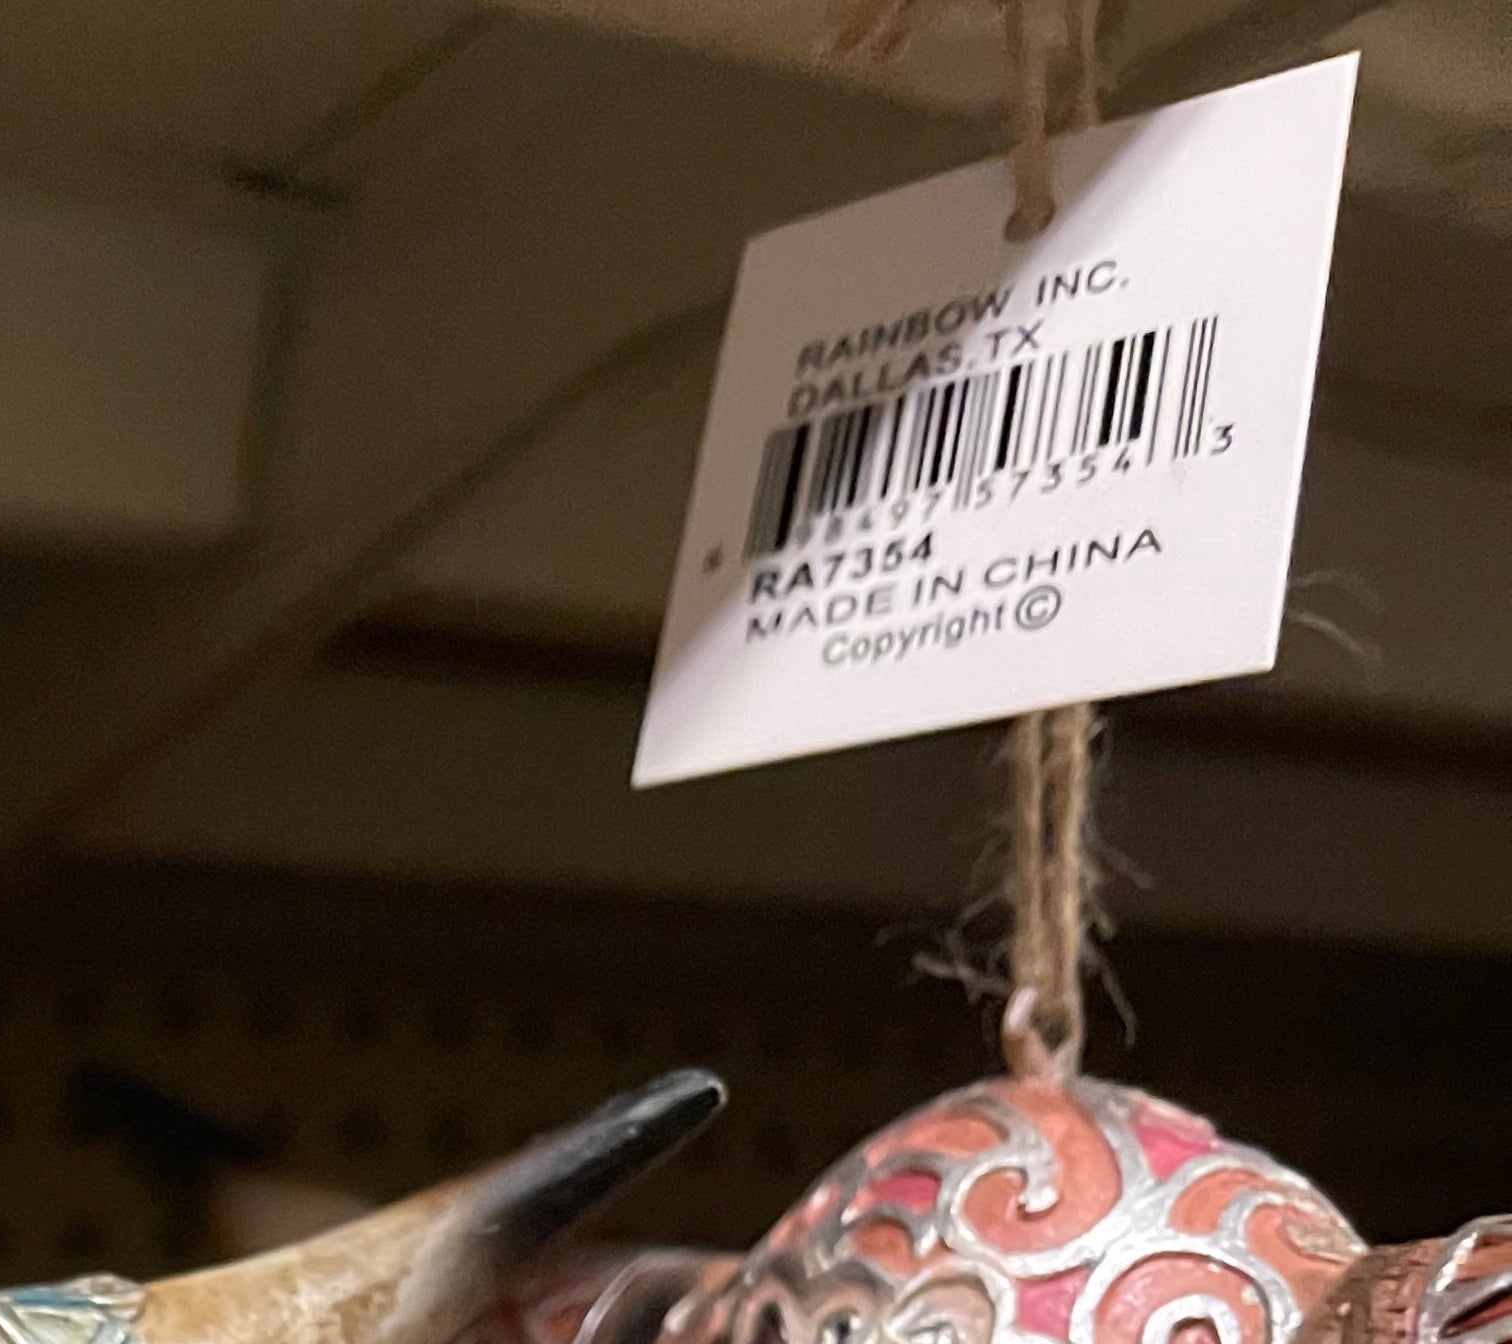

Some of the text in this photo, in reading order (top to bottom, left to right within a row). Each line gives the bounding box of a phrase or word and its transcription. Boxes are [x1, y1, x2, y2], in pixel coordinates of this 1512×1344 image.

[795, 259, 1130, 377] RAINBOW INC.
[745, 527, 1164, 643] MADE IN CHINA
[751, 531, 935, 604] RA7354
[821, 604, 1005, 667] Copyright
